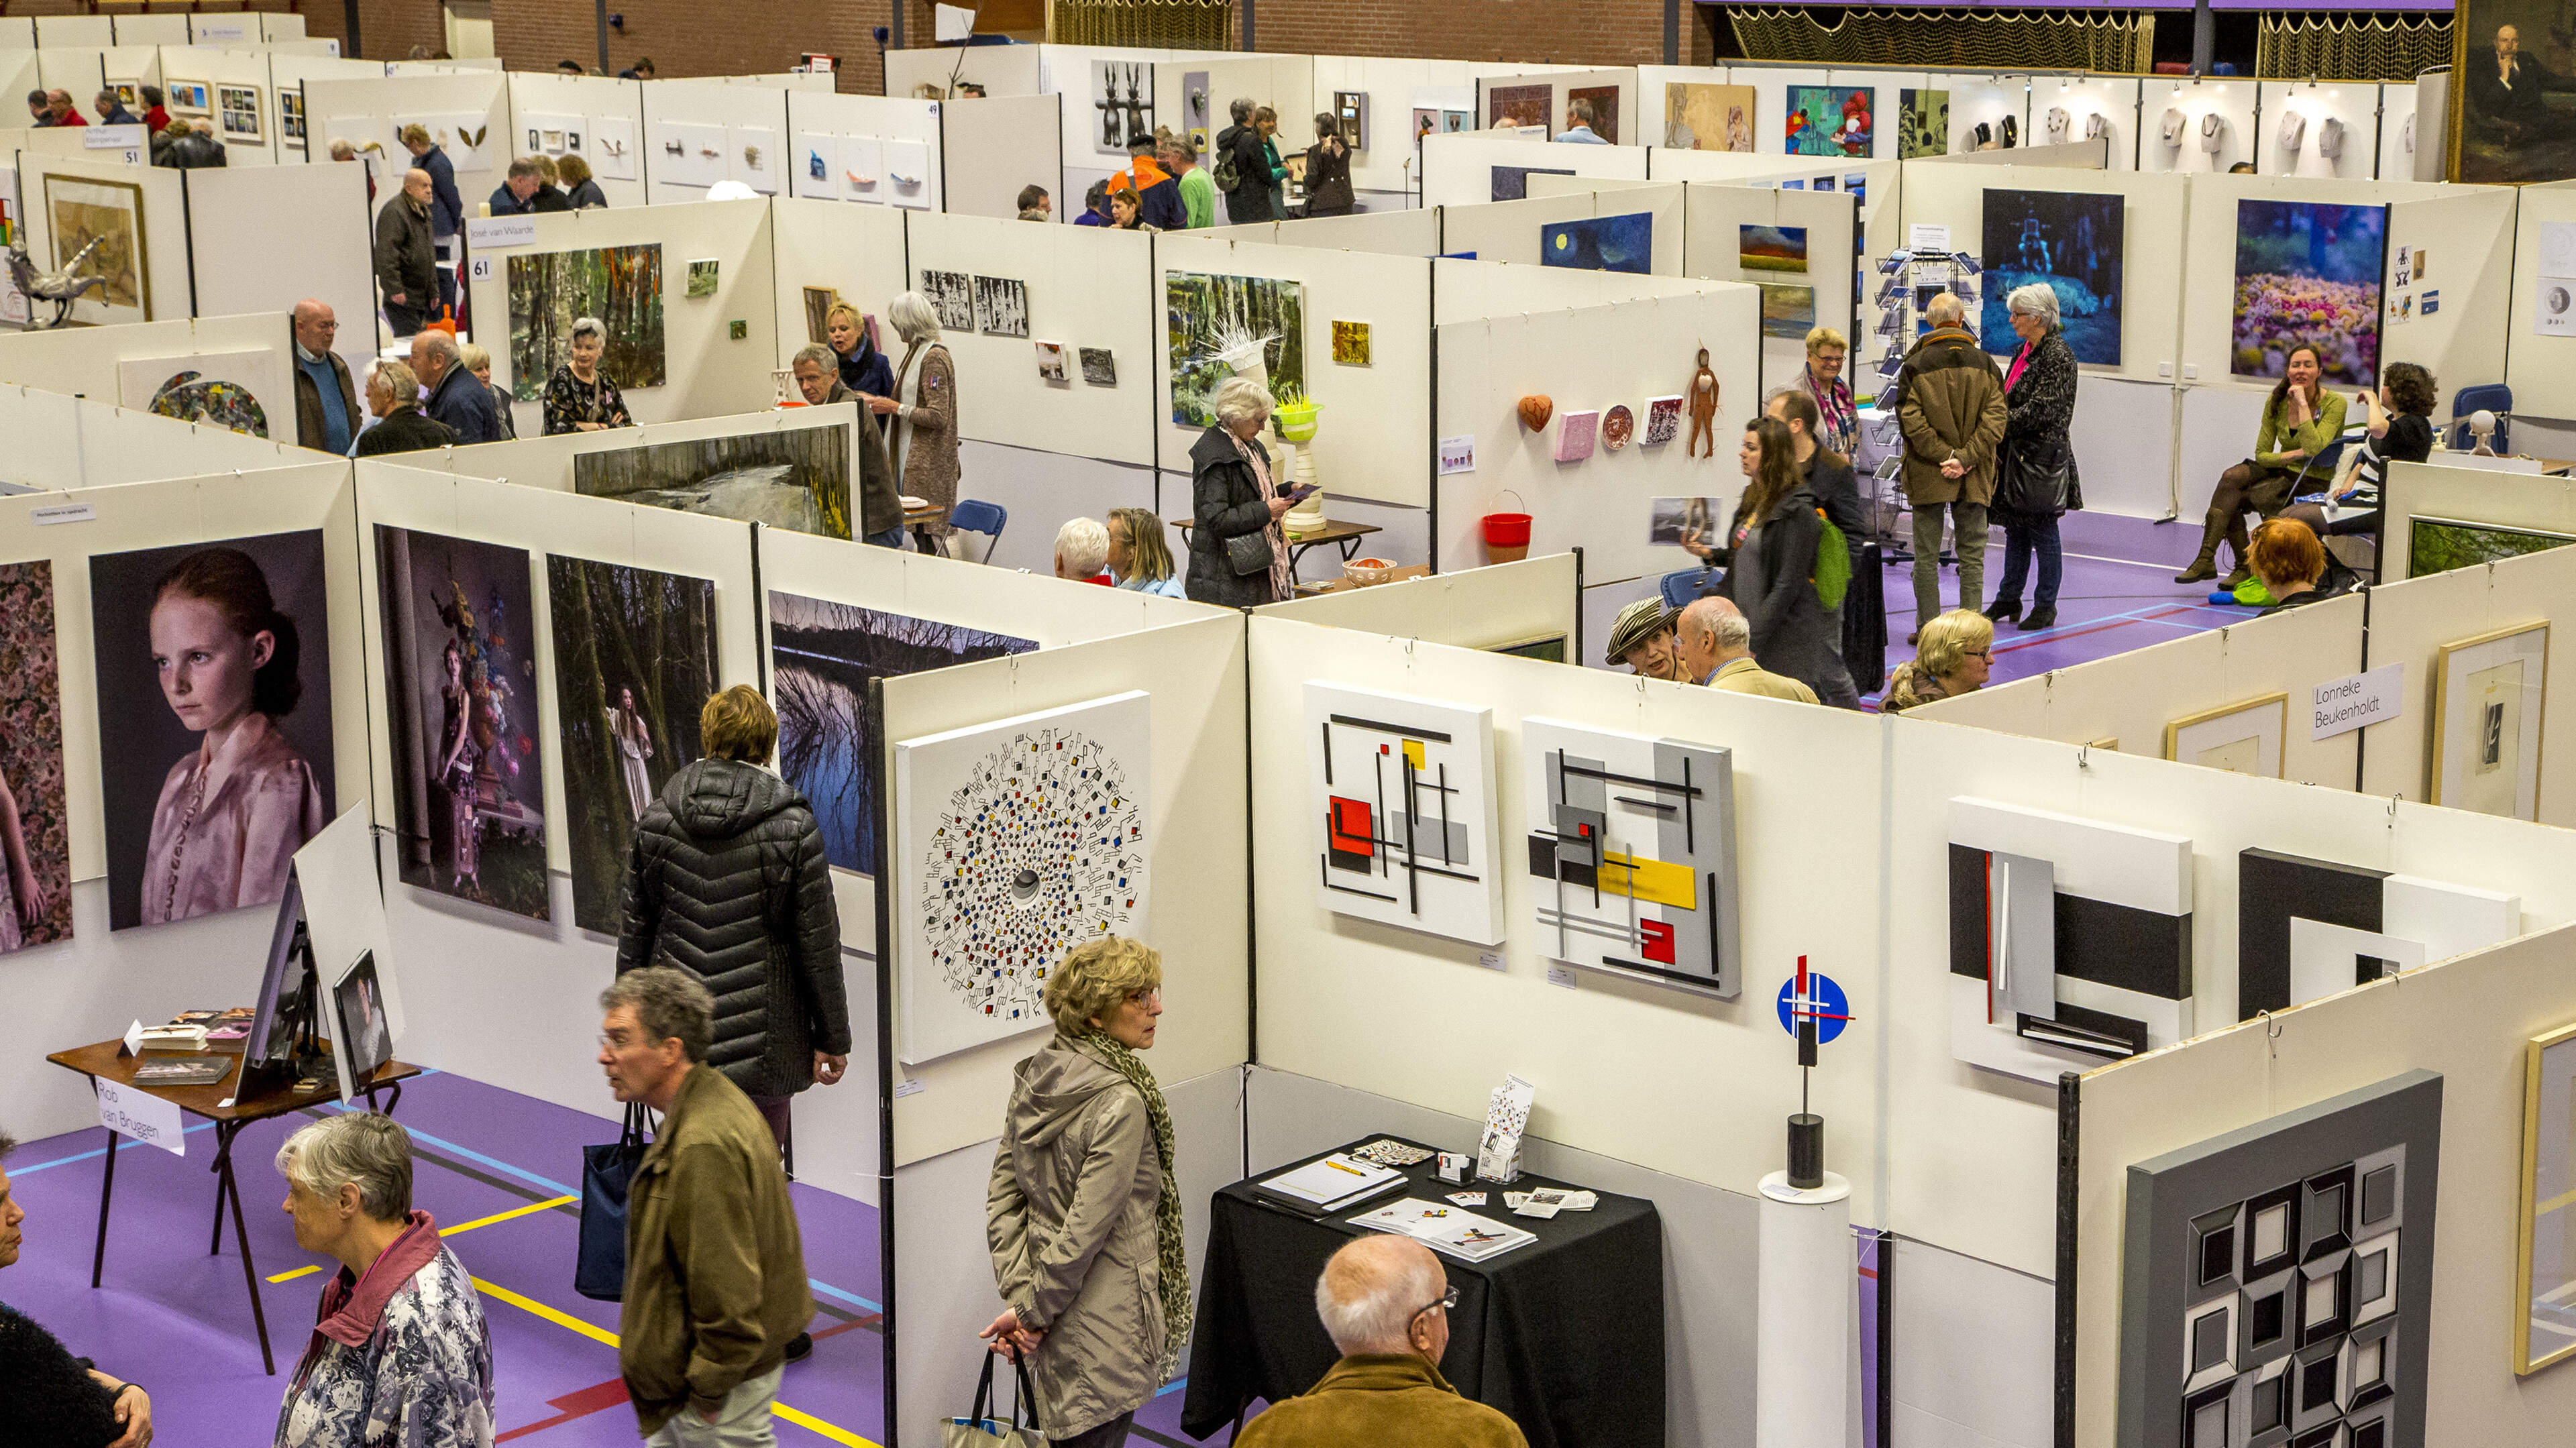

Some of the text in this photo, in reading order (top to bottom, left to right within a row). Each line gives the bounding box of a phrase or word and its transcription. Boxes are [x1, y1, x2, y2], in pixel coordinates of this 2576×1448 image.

[928, 105, 937, 114] 49
[125, 152, 138, 163] 51
[470, 225, 534, 240] José van Waarde
[474, 261, 488, 276] 61
[2316, 679, 2361, 705] Lonneke
[2315, 695, 2380, 728] Beukenholdt
[97, 1081, 118, 1103] Rob
[101, 1109, 160, 1140] van Bruggen
